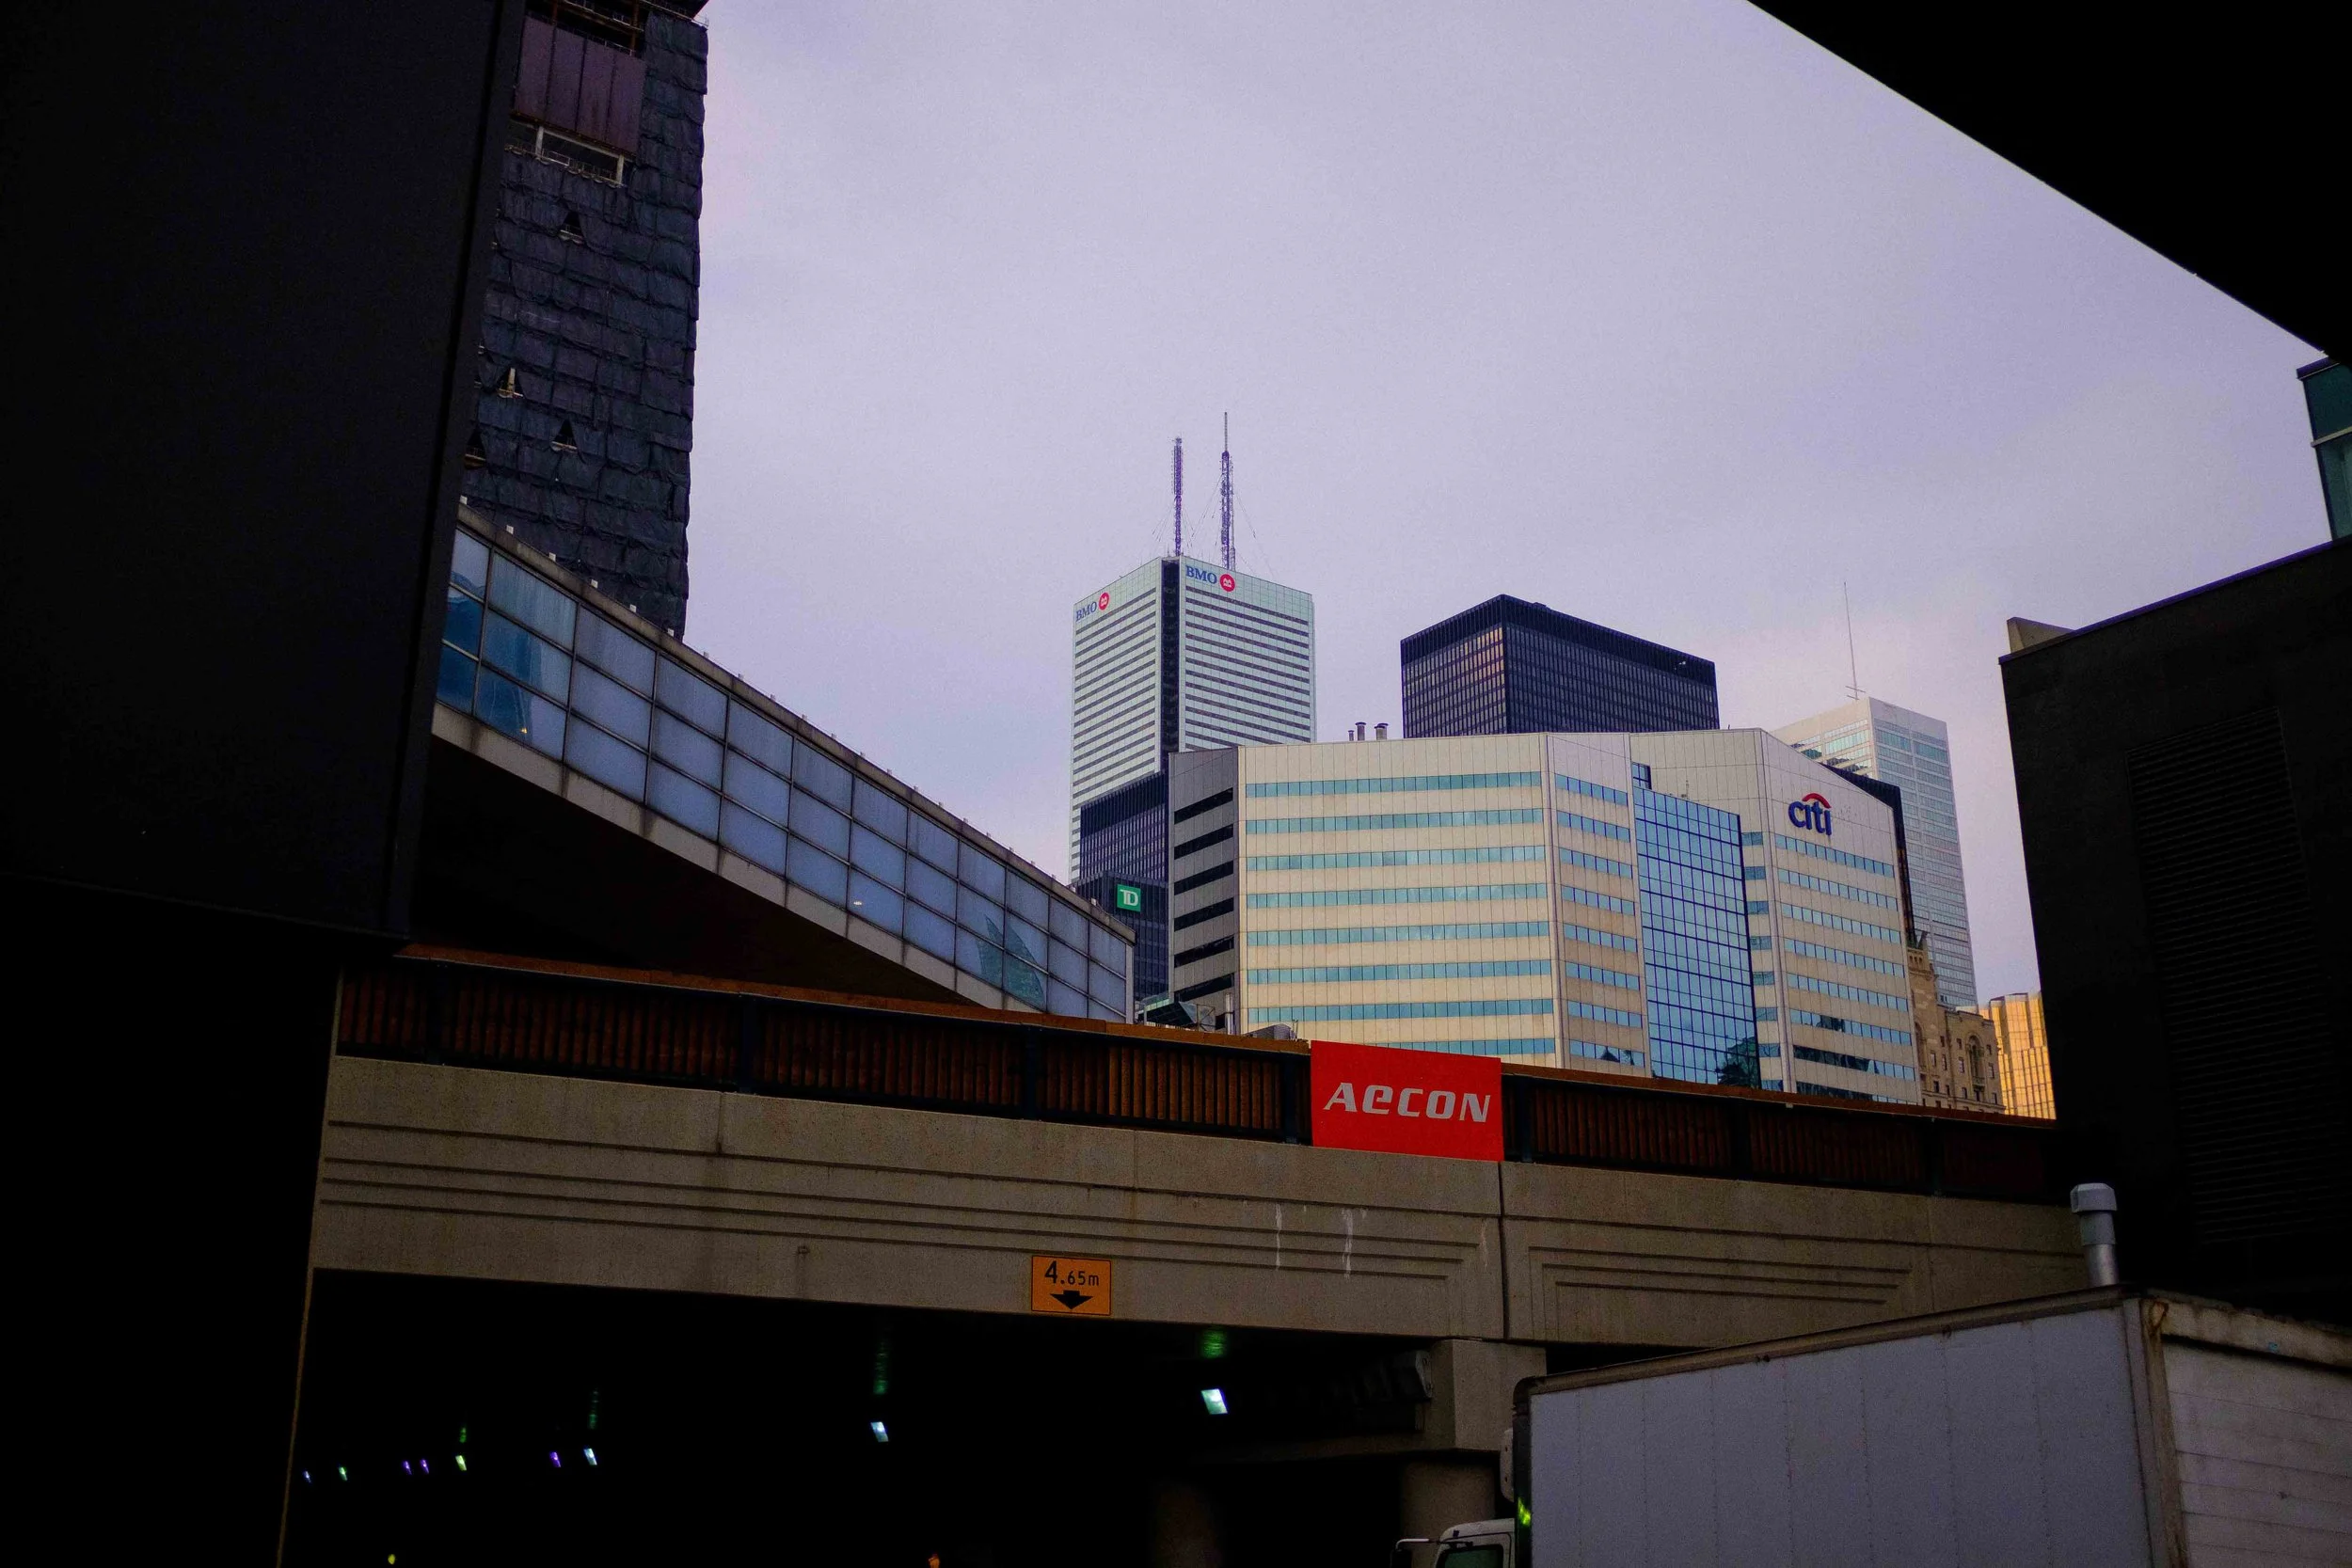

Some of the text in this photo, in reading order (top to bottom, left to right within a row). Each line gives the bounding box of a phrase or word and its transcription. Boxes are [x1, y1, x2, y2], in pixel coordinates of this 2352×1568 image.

[1185, 564, 1217, 584] BMO
[1075, 601, 1098, 621] BMO
[1788, 800, 1832, 836] citi
[1120, 889, 1138, 906] TD
[1044, 1260, 1099, 1287] 4.65m
